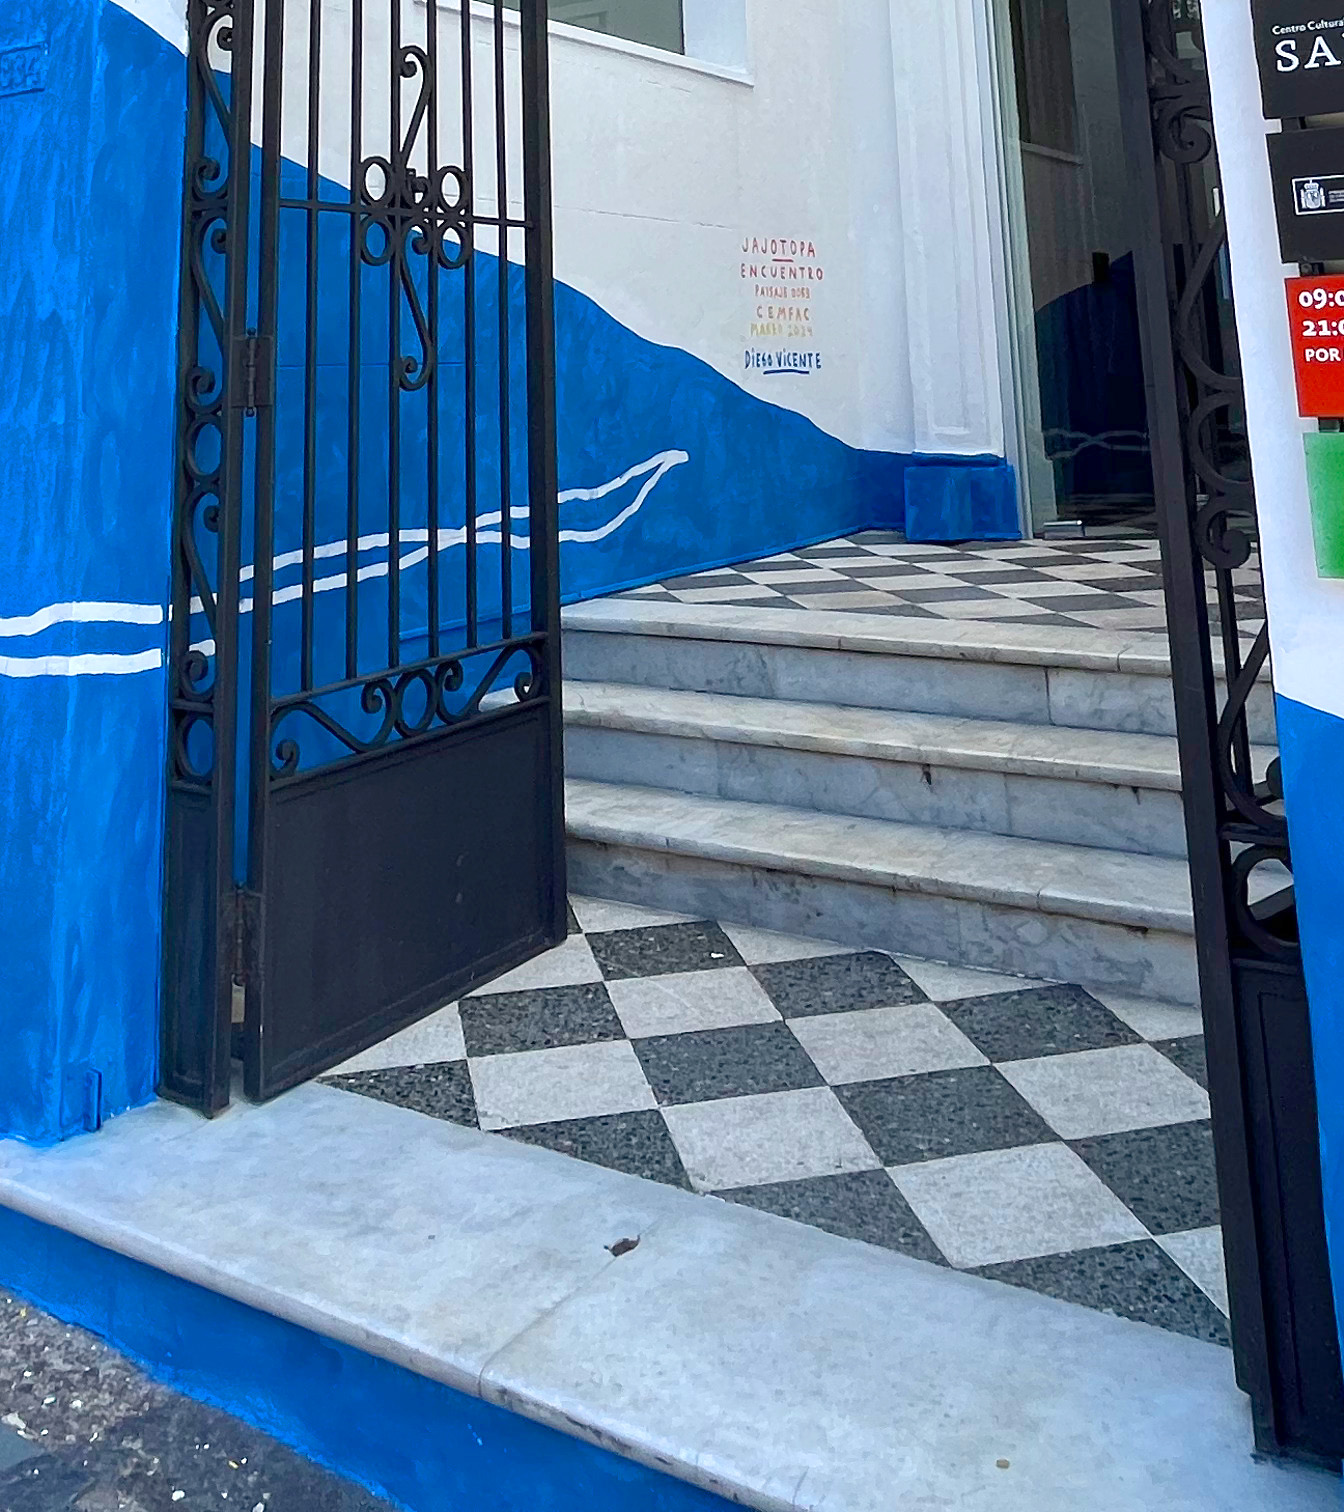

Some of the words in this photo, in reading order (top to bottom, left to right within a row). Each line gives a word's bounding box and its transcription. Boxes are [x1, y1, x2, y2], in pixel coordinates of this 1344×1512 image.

[1272, 24, 1306, 35] Centro
[742, 237, 816, 257] JAJOTOPA
[740, 263, 824, 280] ENCUENTRO
[1305, 348, 1341, 362] POR
